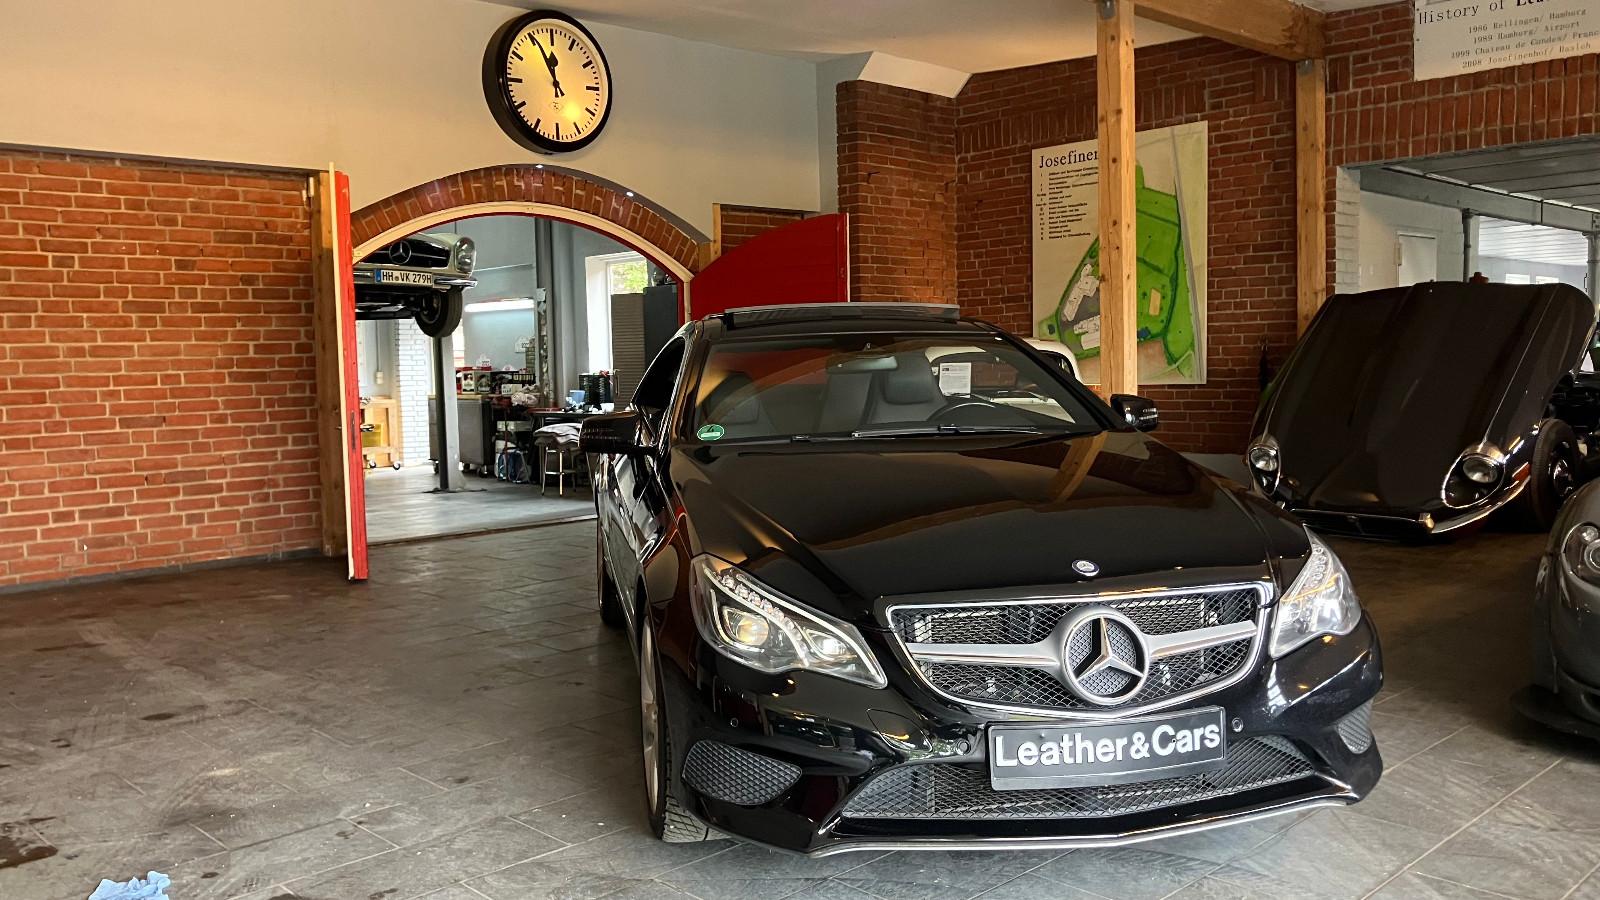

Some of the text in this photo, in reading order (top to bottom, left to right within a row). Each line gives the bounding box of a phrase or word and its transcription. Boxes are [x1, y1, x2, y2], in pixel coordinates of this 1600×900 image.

[1419, 4, 1480, 25] History
[1468, 25, 1488, 34] 1986
[1549, 9, 1587, 20] Hamburg
[1473, 35, 1493, 44] 1989
[1544, 21, 1580, 32] Airport
